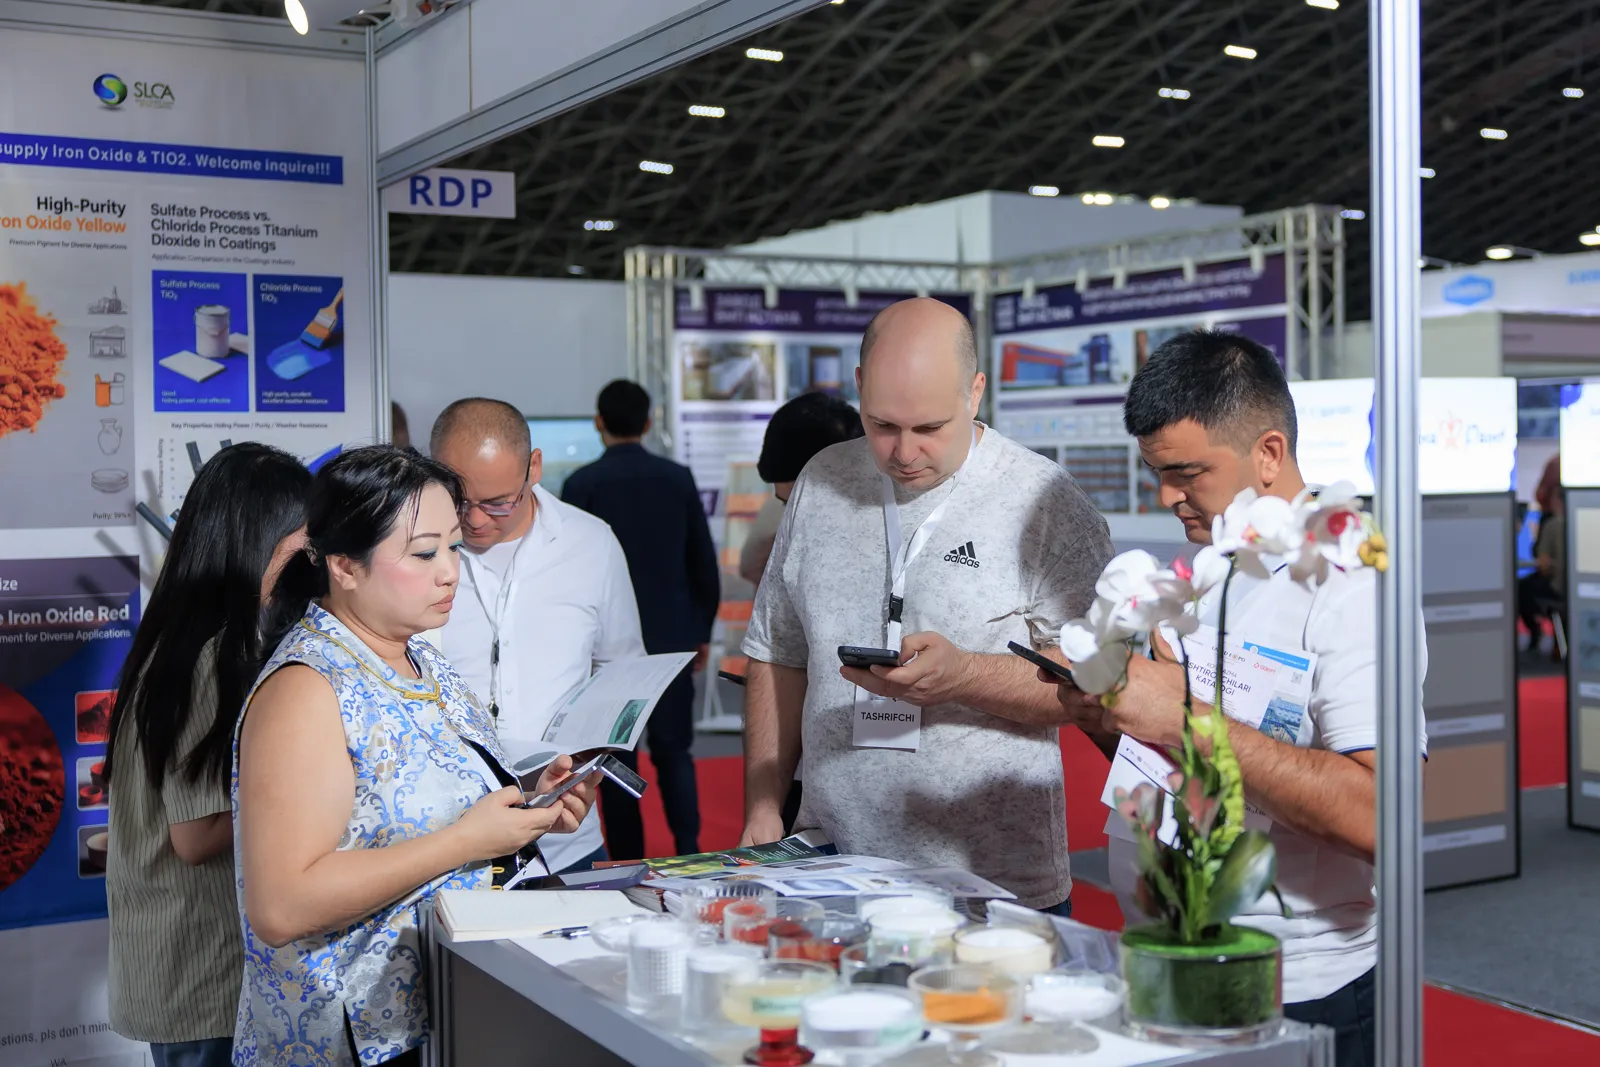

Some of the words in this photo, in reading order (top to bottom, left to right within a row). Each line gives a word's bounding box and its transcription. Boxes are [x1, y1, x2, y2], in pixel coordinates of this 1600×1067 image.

[134, 81, 175, 100] SLCA
[53, 144, 84, 159] Iron
[88, 147, 133, 162] Oxide
[137, 151, 147, 163] &
[195, 154, 261, 170] Welcome
[409, 175, 492, 209] RDP
[37, 196, 126, 218] High-Purity
[151, 203, 197, 218] Sulfate
[200, 206, 250, 221] Process
[253, 211, 271, 222] vs.
[26, 214, 72, 231] Oxide
[76, 217, 127, 233] Yellow
[151, 218, 206, 233] Chloride
[209, 221, 260, 236] Process
[264, 223, 319, 239] Titanium
[151, 233, 200, 248] Dioxide
[204, 235, 216, 249] in
[219, 236, 276, 254] Coatings
[160, 279, 187, 289] Sulfate
[189, 281, 220, 290] Process
[260, 283, 291, 292] Chloride
[293, 284, 322, 293] Process
[943, 554, 980, 569] adidas
[8, 609, 42, 625] Iron
[45, 606, 94, 624] Oxide
[97, 604, 129, 621] Red
[25, 632, 39, 643] for
[40, 631, 74, 642] Diverse
[75, 628, 131, 641] Applications
[1196, 675, 1235, 695] KATAOGI
[861, 712, 915, 722] TASHRIFCHI
[41, 1028, 57, 1043] pls
[59, 1023, 86, 1039] don't
